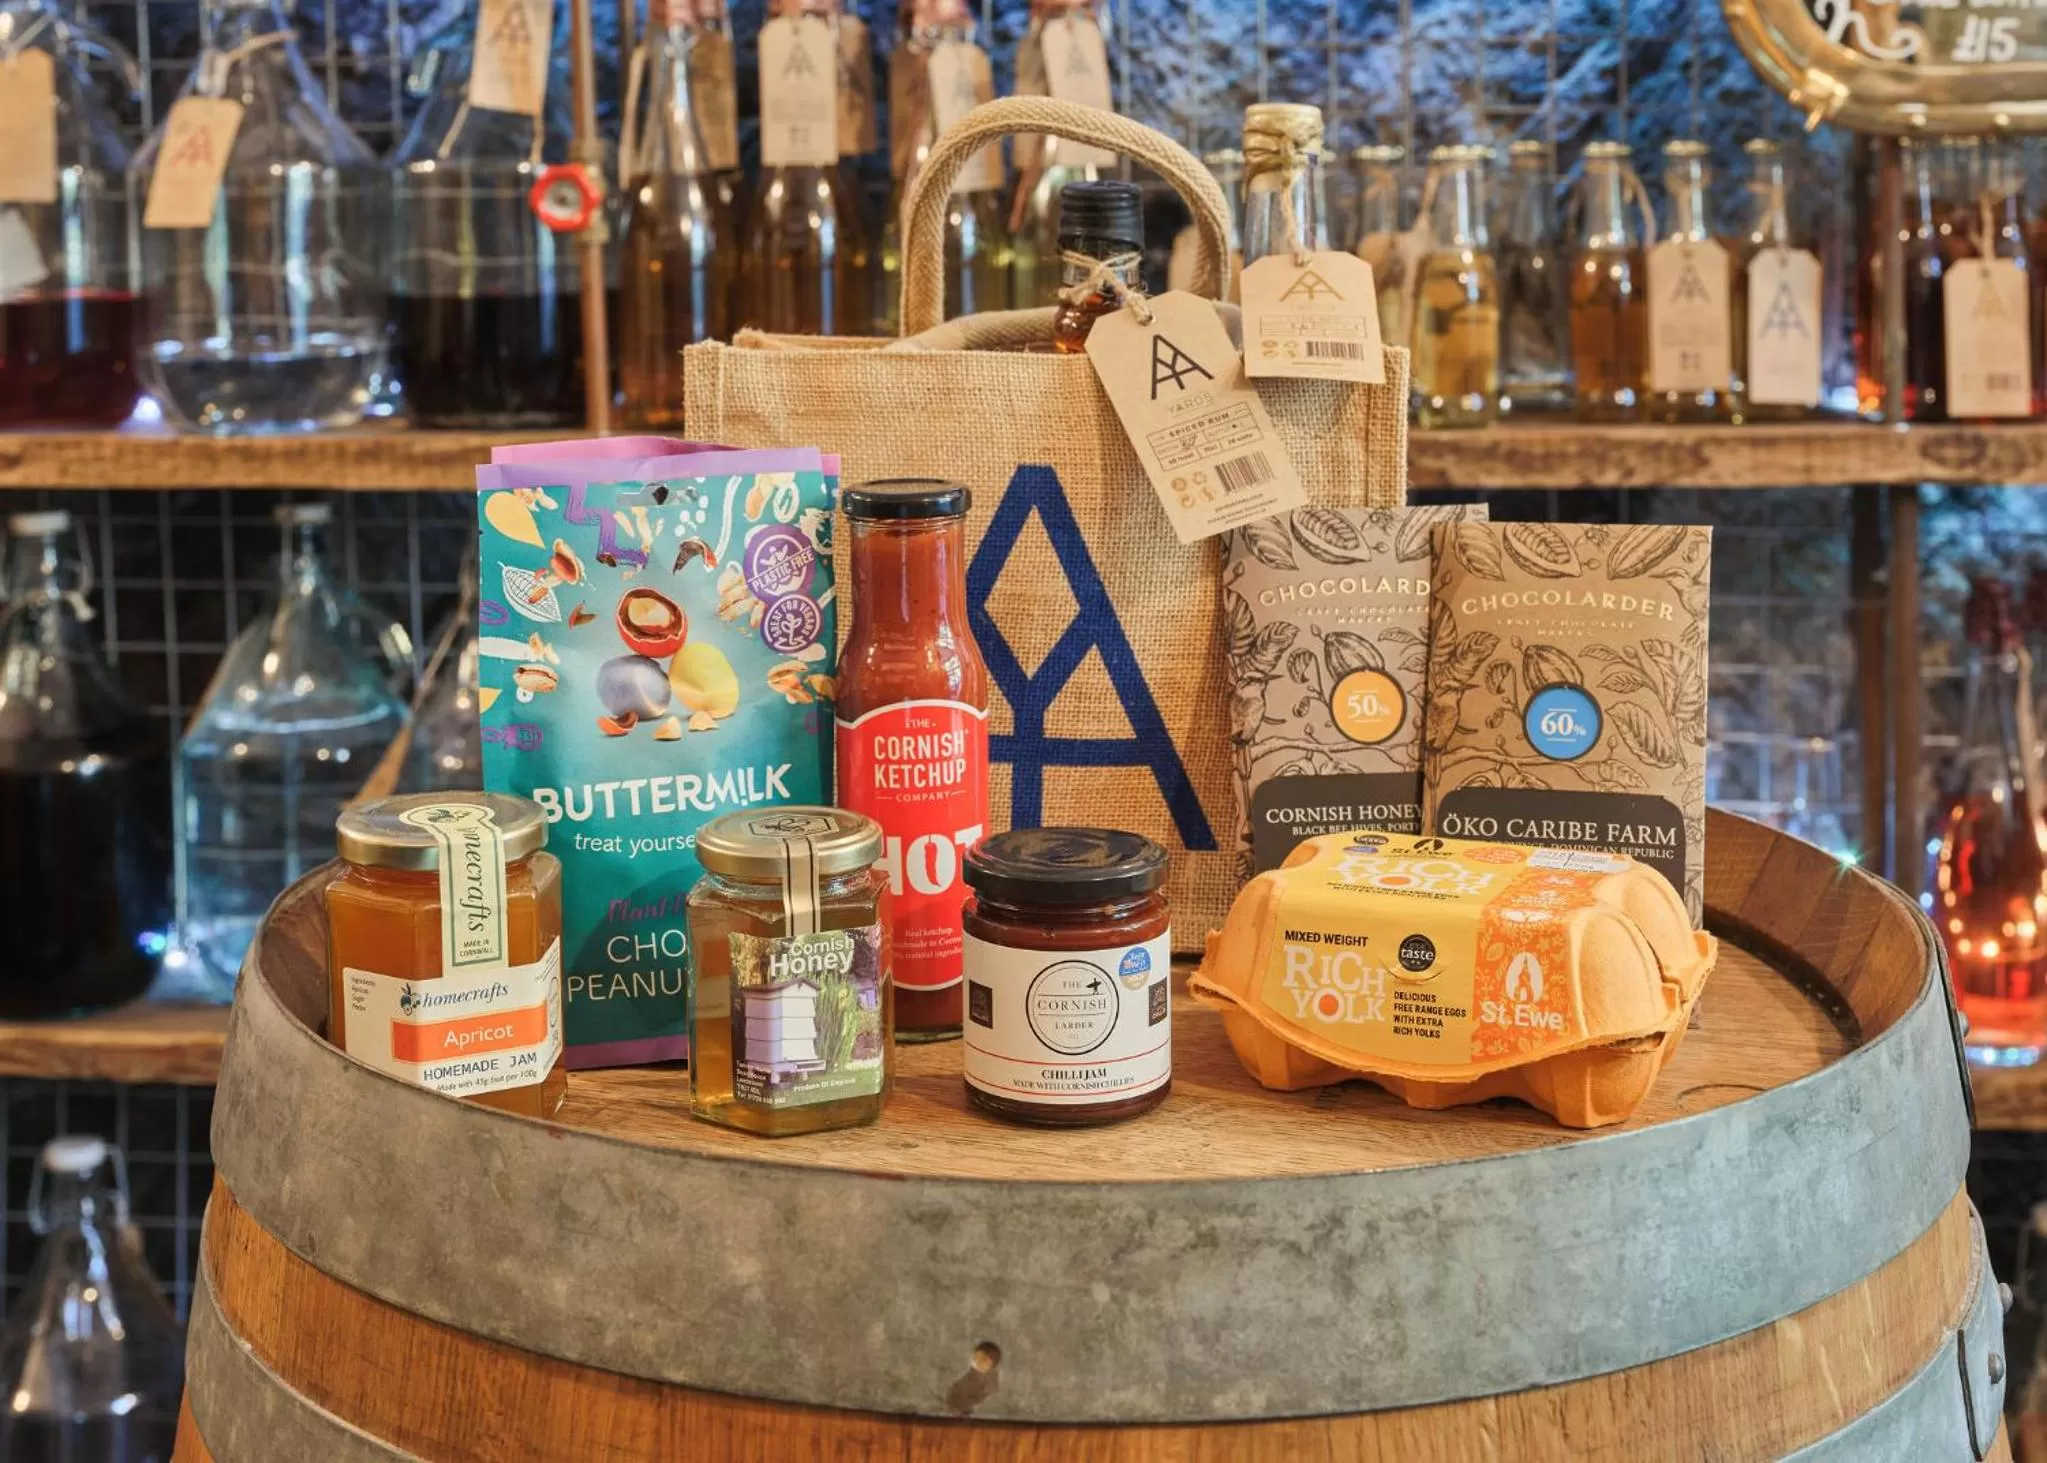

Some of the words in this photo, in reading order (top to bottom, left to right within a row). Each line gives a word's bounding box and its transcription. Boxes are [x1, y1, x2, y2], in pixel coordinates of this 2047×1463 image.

[752, 562, 793, 592] PLASTIC
[790, 549, 815, 570] FREE
[1259, 577, 1431, 606] CHOCOLARD
[781, 600, 798, 613] FOR
[1462, 590, 1674, 621] CHOCOLARDER
[1347, 693, 1391, 719] 50%
[1540, 714, 1587, 737] 60%
[874, 729, 965, 760] CORNISH
[874, 758, 966, 789] KETCHUP
[896, 791, 951, 803] COMPANY
[1266, 806, 1352, 823] CORNISH
[1292, 825, 1327, 836] BLACK
[1442, 813, 1498, 837] ÖKO
[1507, 818, 1598, 841] CARIBE
[1607, 823, 1677, 846] FARM
[574, 833, 623, 853] treat
[629, 828, 699, 859] yourse
[1622, 847, 1674, 860] REPUBLIC
[607, 929, 687, 963] CHO
[791, 935, 855, 956] Cornish
[1285, 930, 1321, 943] MIXED
[1324, 933, 1369, 947] WEIGHT
[770, 950, 855, 977] Honey
[1401, 948, 1434, 960] taste
[1283, 945, 1386, 997] RICH
[422, 982, 509, 1008] homecrafts
[1061, 981, 1082, 989] THE
[1037, 998, 1106, 1011] CORNISH
[1291, 987, 1386, 1025] YOLK
[1394, 991, 1437, 1003] DELICIOUS
[1394, 1003, 1414, 1013] FREE
[1415, 1005, 1443, 1016] RANGE
[1444, 1008, 1467, 1017] EGGS
[1055, 1021, 1094, 1030] LARDER
[1393, 1015, 1415, 1025] WITH
[1416, 1017, 1444, 1027] EXTRA
[444, 1025, 514, 1051] Apricot
[1393, 1026, 1413, 1036] RICH
[1414, 1028, 1441, 1039] YOLKS
[424, 1058, 499, 1081] HOMEMADE
[509, 1052, 537, 1068] JAM
[505, 1073, 518, 1083] per
[1013, 1079, 1034, 1088] MADE
[1036, 1081, 1061, 1090] WITH
[1061, 1081, 1100, 1090] CORNISH
